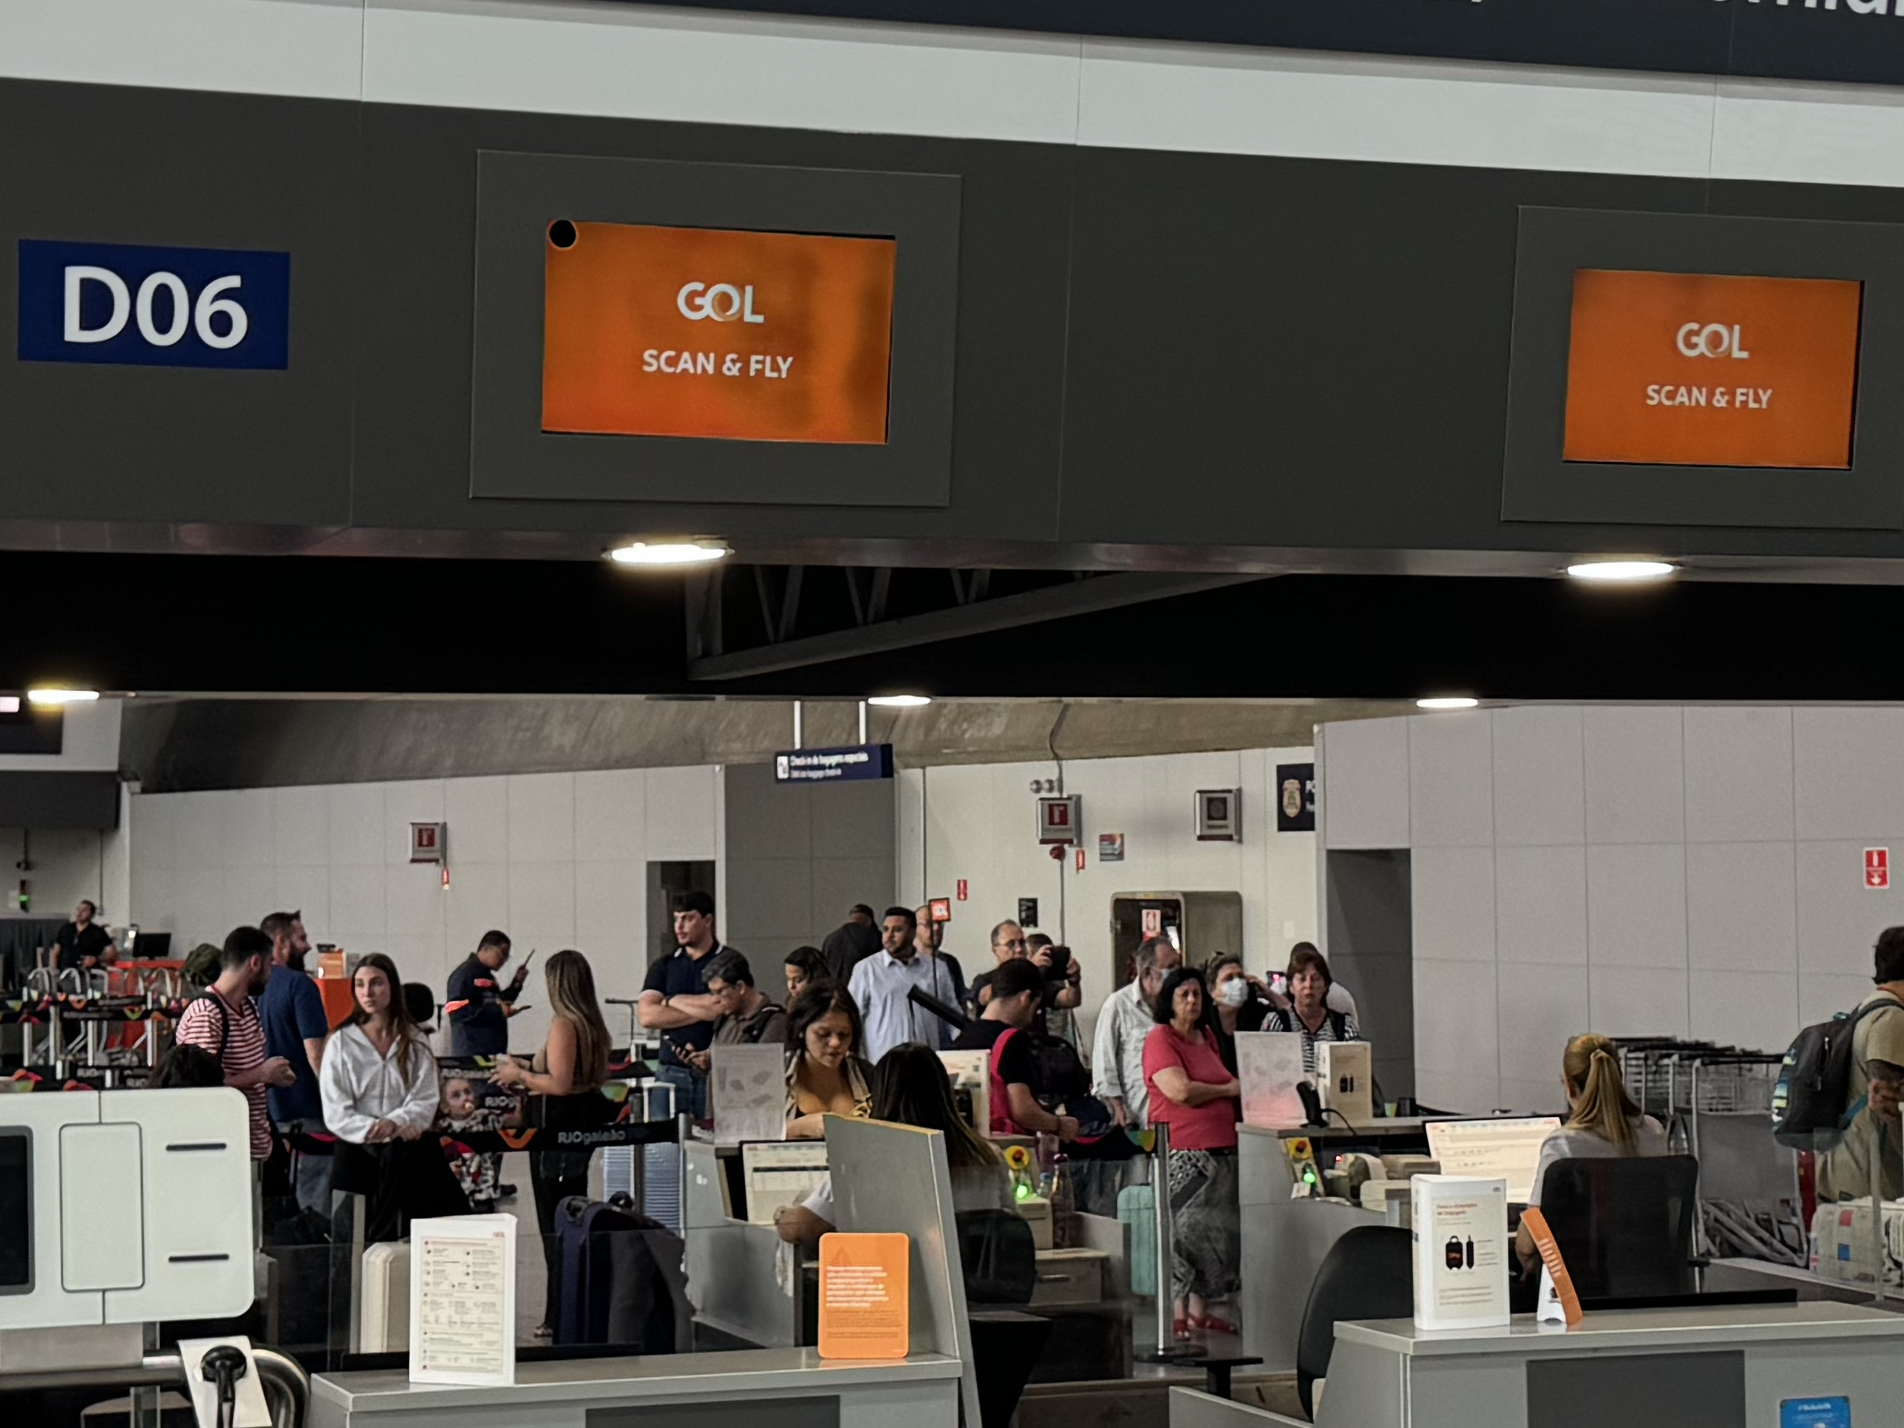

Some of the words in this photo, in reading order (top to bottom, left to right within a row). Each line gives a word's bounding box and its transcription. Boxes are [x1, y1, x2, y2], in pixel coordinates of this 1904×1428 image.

[63, 265, 249, 350] D06
[677, 281, 765, 324] GOL
[1676, 322, 1750, 359] GOL
[642, 349, 715, 375] SCAN
[721, 353, 743, 377] &
[749, 354, 794, 379] FLY
[1646, 384, 1706, 407] SCAN
[1712, 387, 1730, 408] &
[1735, 388, 1773, 409] FLY
